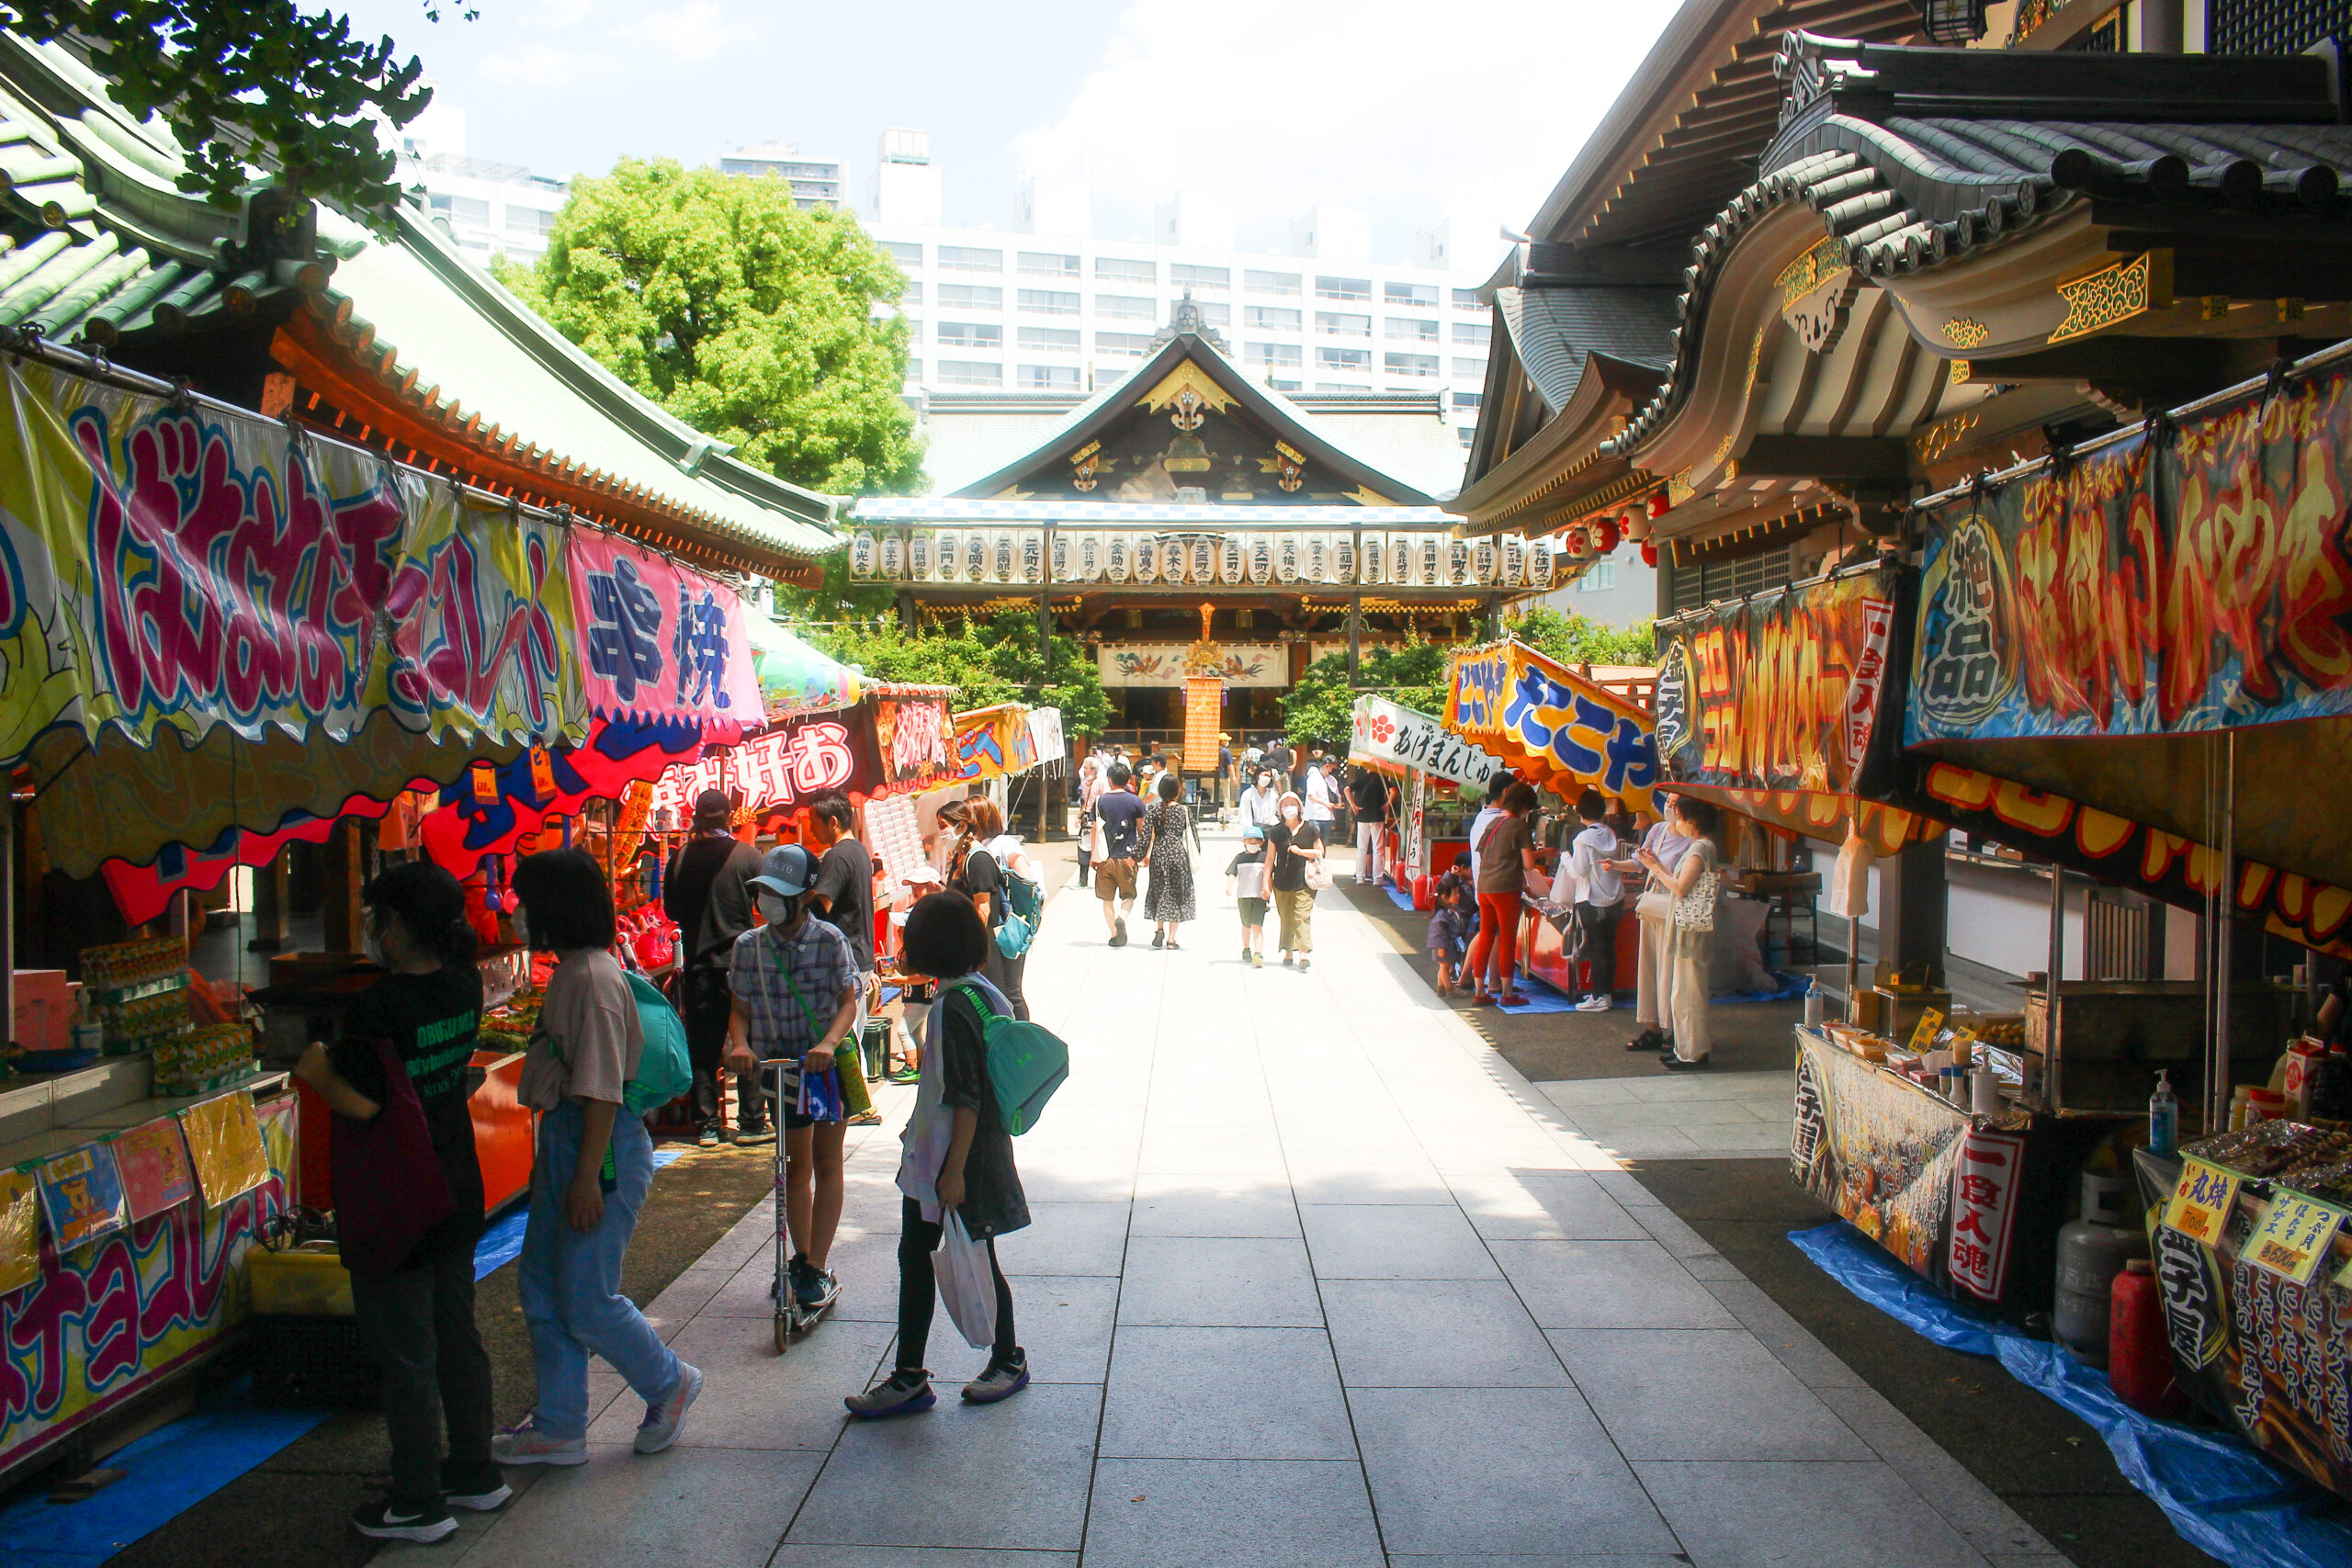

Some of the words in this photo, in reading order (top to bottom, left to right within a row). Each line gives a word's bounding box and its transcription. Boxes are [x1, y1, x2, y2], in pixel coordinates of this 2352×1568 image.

[1926, 525, 1999, 704] 絶品
[1393, 725, 1505, 784] あげまんじゅ
[2178, 1162, 2196, 1198] いか
[2187, 1168, 2228, 1212] 丸焼
[1952, 1148, 2007, 1281] 一食入魂
[2264, 1197, 2291, 1235] サザエ
[2285, 1203, 2310, 1241] ほたて
[2299, 1210, 2331, 1251] つぶ貝
